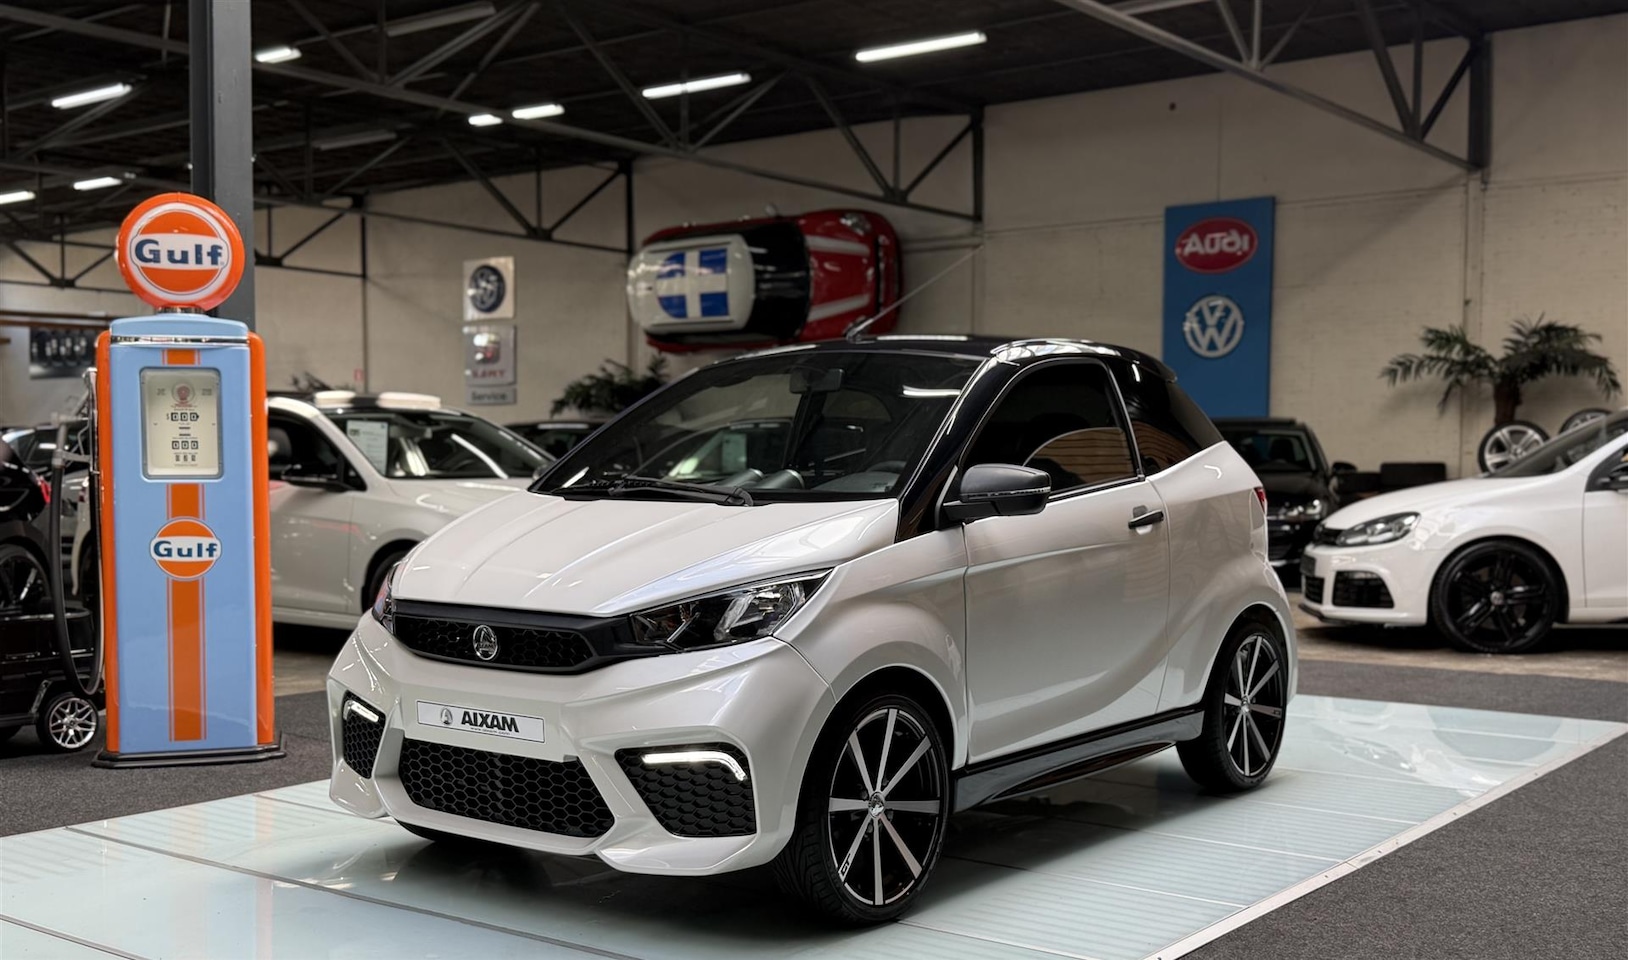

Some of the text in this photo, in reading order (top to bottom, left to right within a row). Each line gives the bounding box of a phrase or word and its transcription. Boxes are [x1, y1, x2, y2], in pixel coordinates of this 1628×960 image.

[134, 239, 223, 266] Gulf
[153, 540, 218, 558] Gulf
[461, 711, 519, 733] AIXAM
